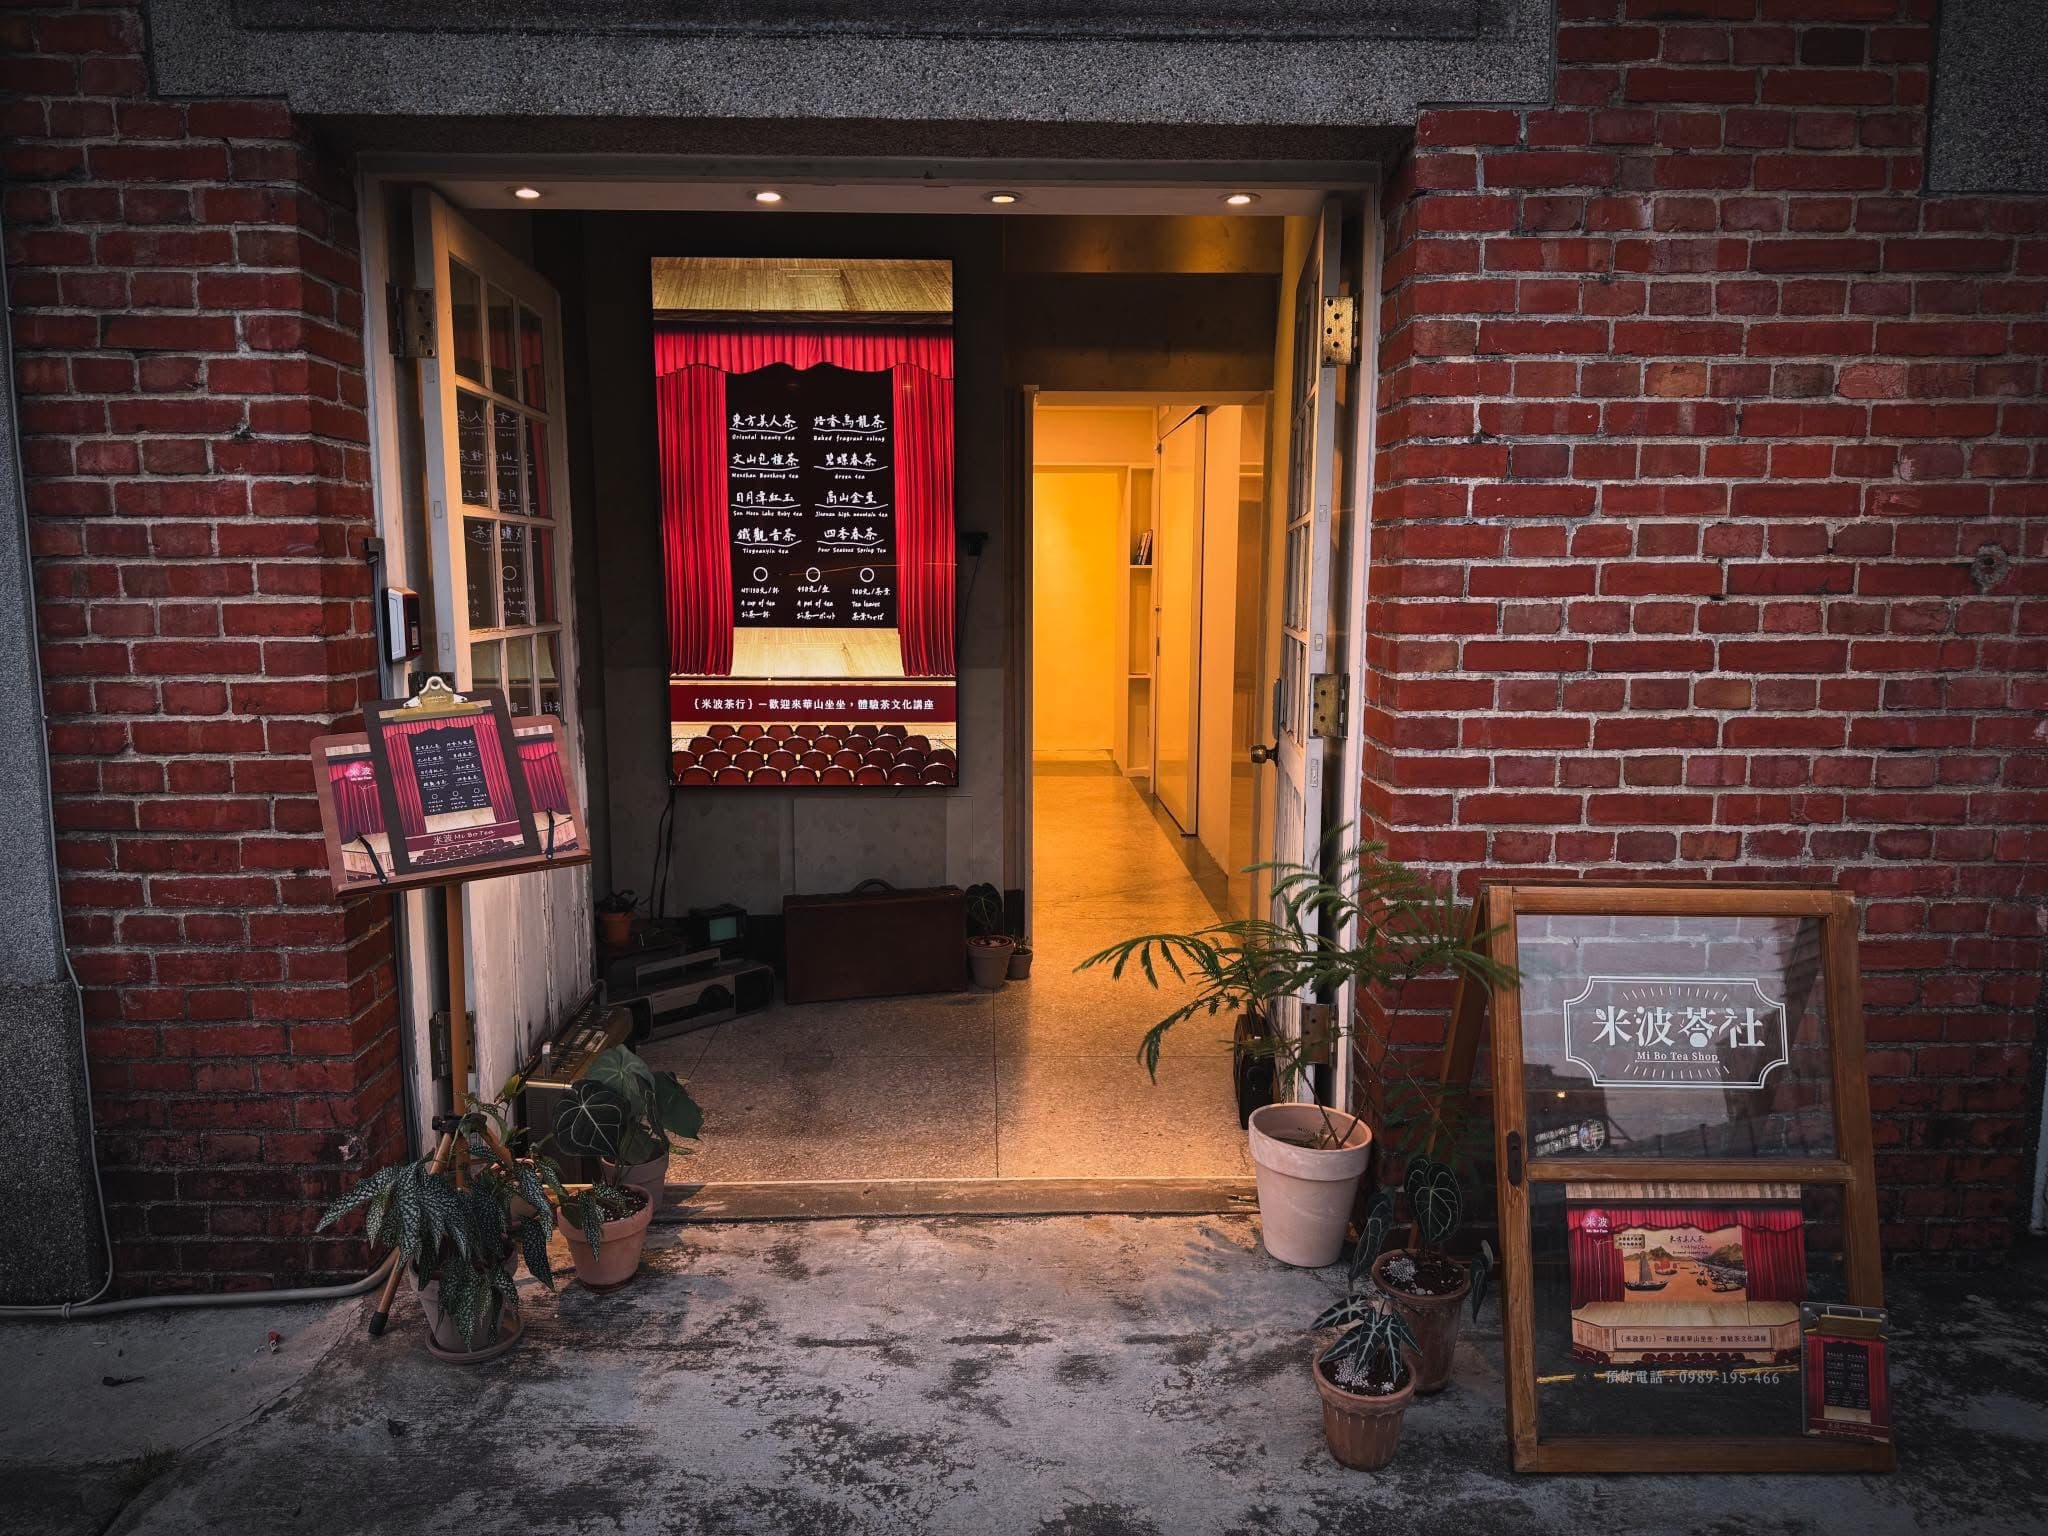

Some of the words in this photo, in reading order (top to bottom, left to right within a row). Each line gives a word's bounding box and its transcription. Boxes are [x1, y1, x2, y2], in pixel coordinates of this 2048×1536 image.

[732, 413, 796, 427] 東方美人茶
[733, 452, 799, 466] 文山包種茶
[826, 453, 876, 466] 碧螺春茶
[737, 491, 794, 505] 日月潭紅玉
[737, 527, 796, 541] 鐵觀音茶
[824, 527, 877, 540] 四季春茶
[1637, 1051, 1650, 1060] Mi
[1654, 1051, 1667, 1060] Bo
[1670, 1052, 1689, 1061] Tea
[1692, 1052, 1718, 1062] Shop
[1586, 1216, 1608, 1228] 米波
